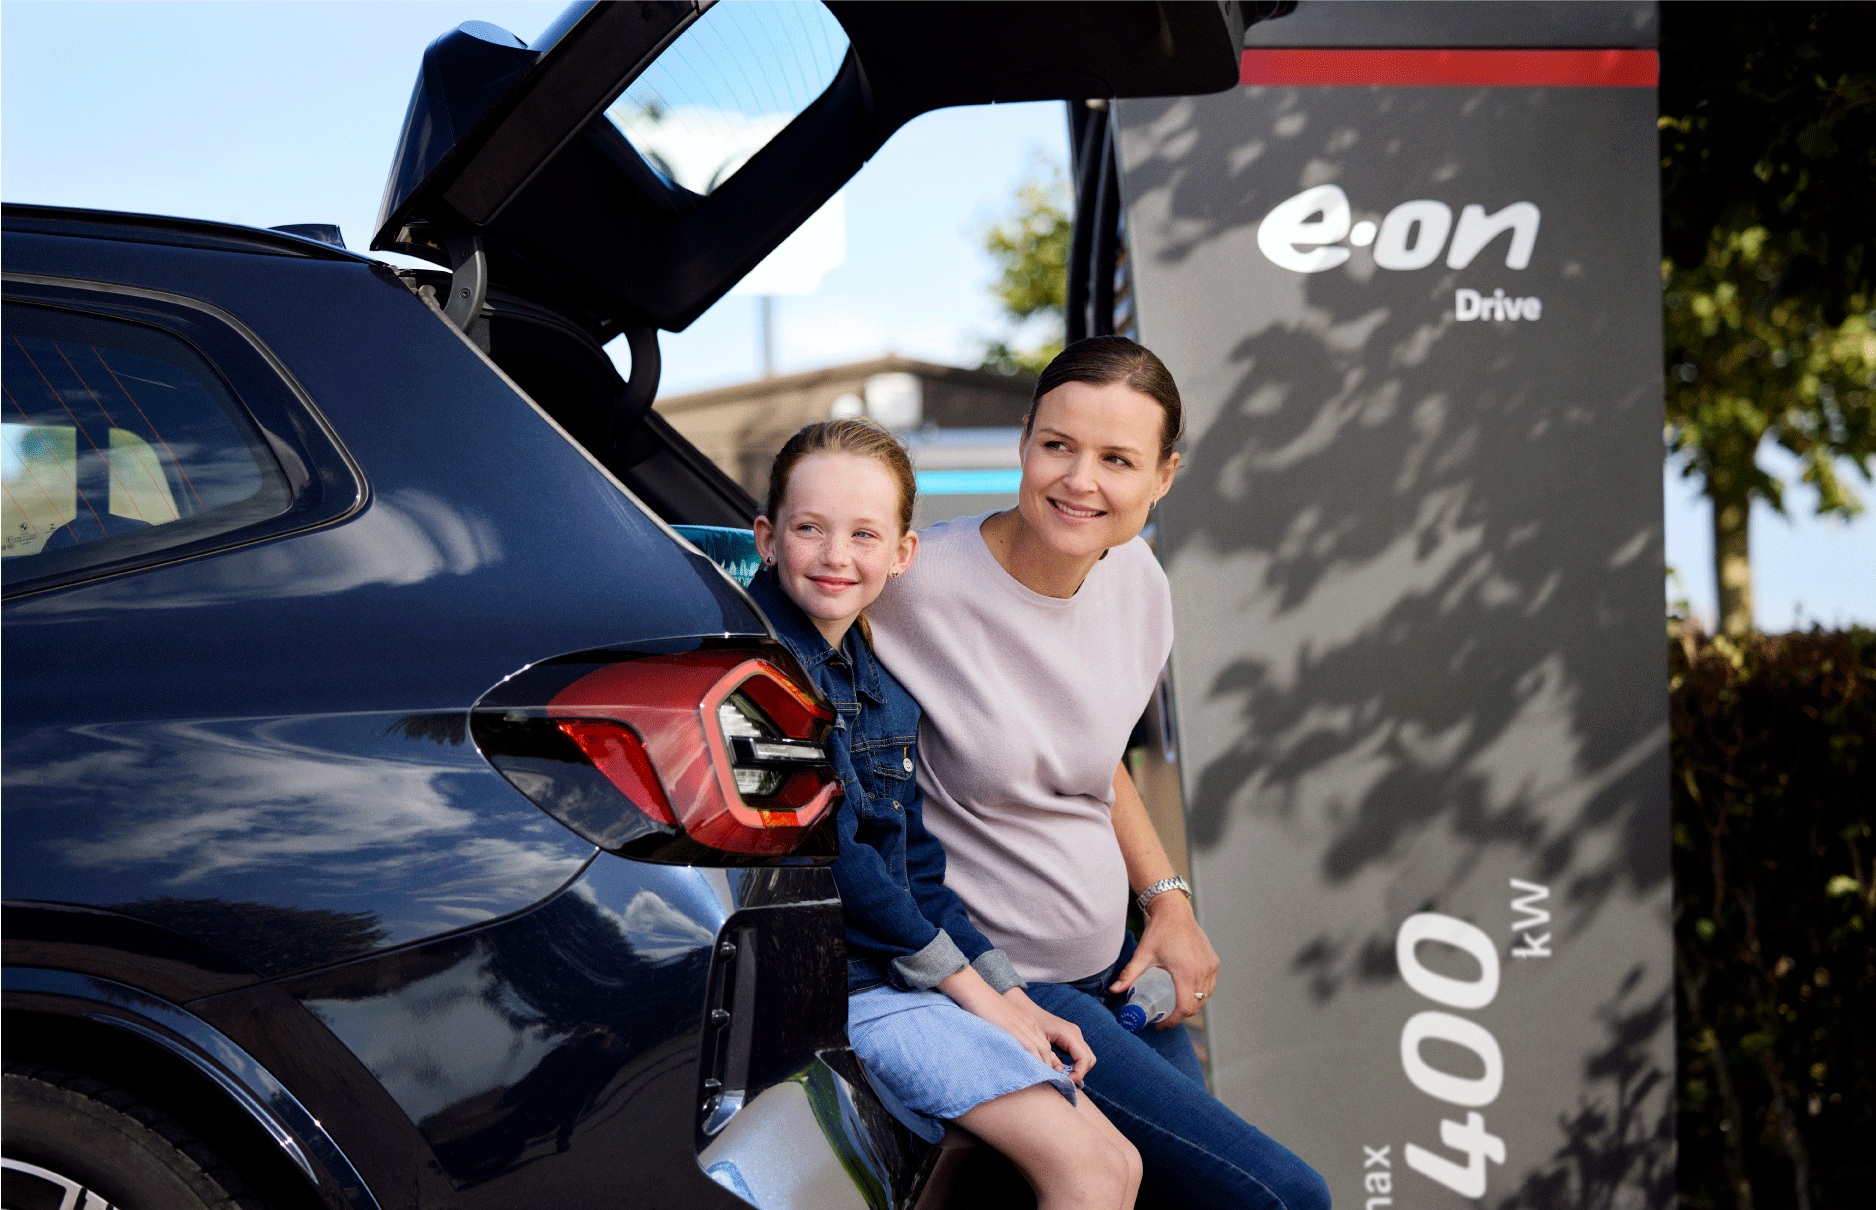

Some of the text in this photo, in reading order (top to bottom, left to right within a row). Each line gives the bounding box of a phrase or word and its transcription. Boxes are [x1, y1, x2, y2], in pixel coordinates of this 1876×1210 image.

[1455, 288, 1542, 322] Drive
[1510, 878, 1552, 958] kW
[1396, 912, 1506, 1198] 400
